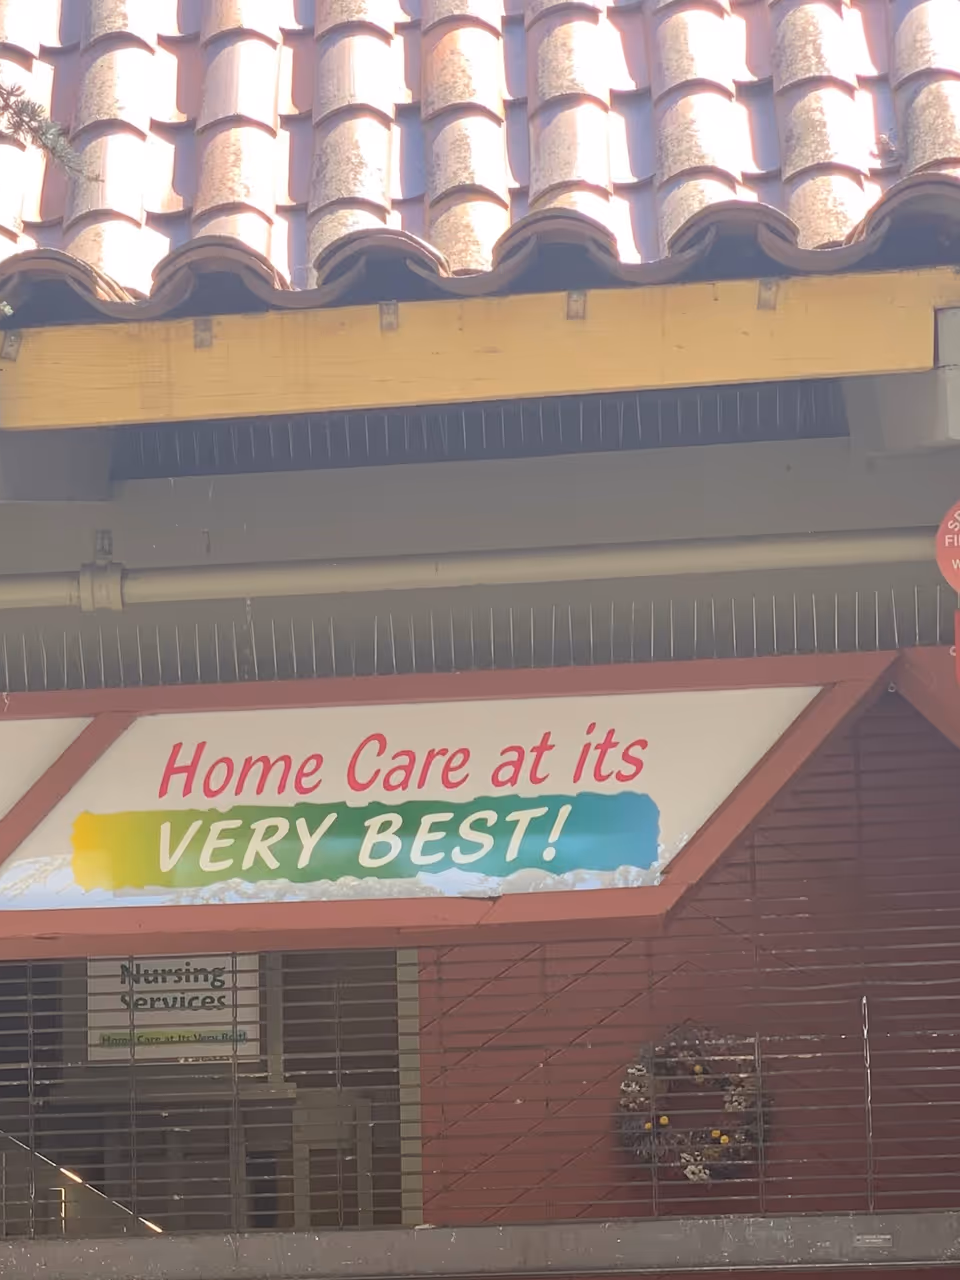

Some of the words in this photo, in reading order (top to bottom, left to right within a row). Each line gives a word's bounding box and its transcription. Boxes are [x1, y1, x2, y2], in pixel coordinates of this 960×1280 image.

[158, 741, 324, 799] Home
[345, 733, 471, 793] Care
[491, 731, 556, 787] at
[572, 722, 649, 783] its
[158, 812, 338, 873] VERY
[357, 804, 573, 868] BEST!
[120, 961, 226, 989] Nursing
[120, 991, 226, 1011] Services
